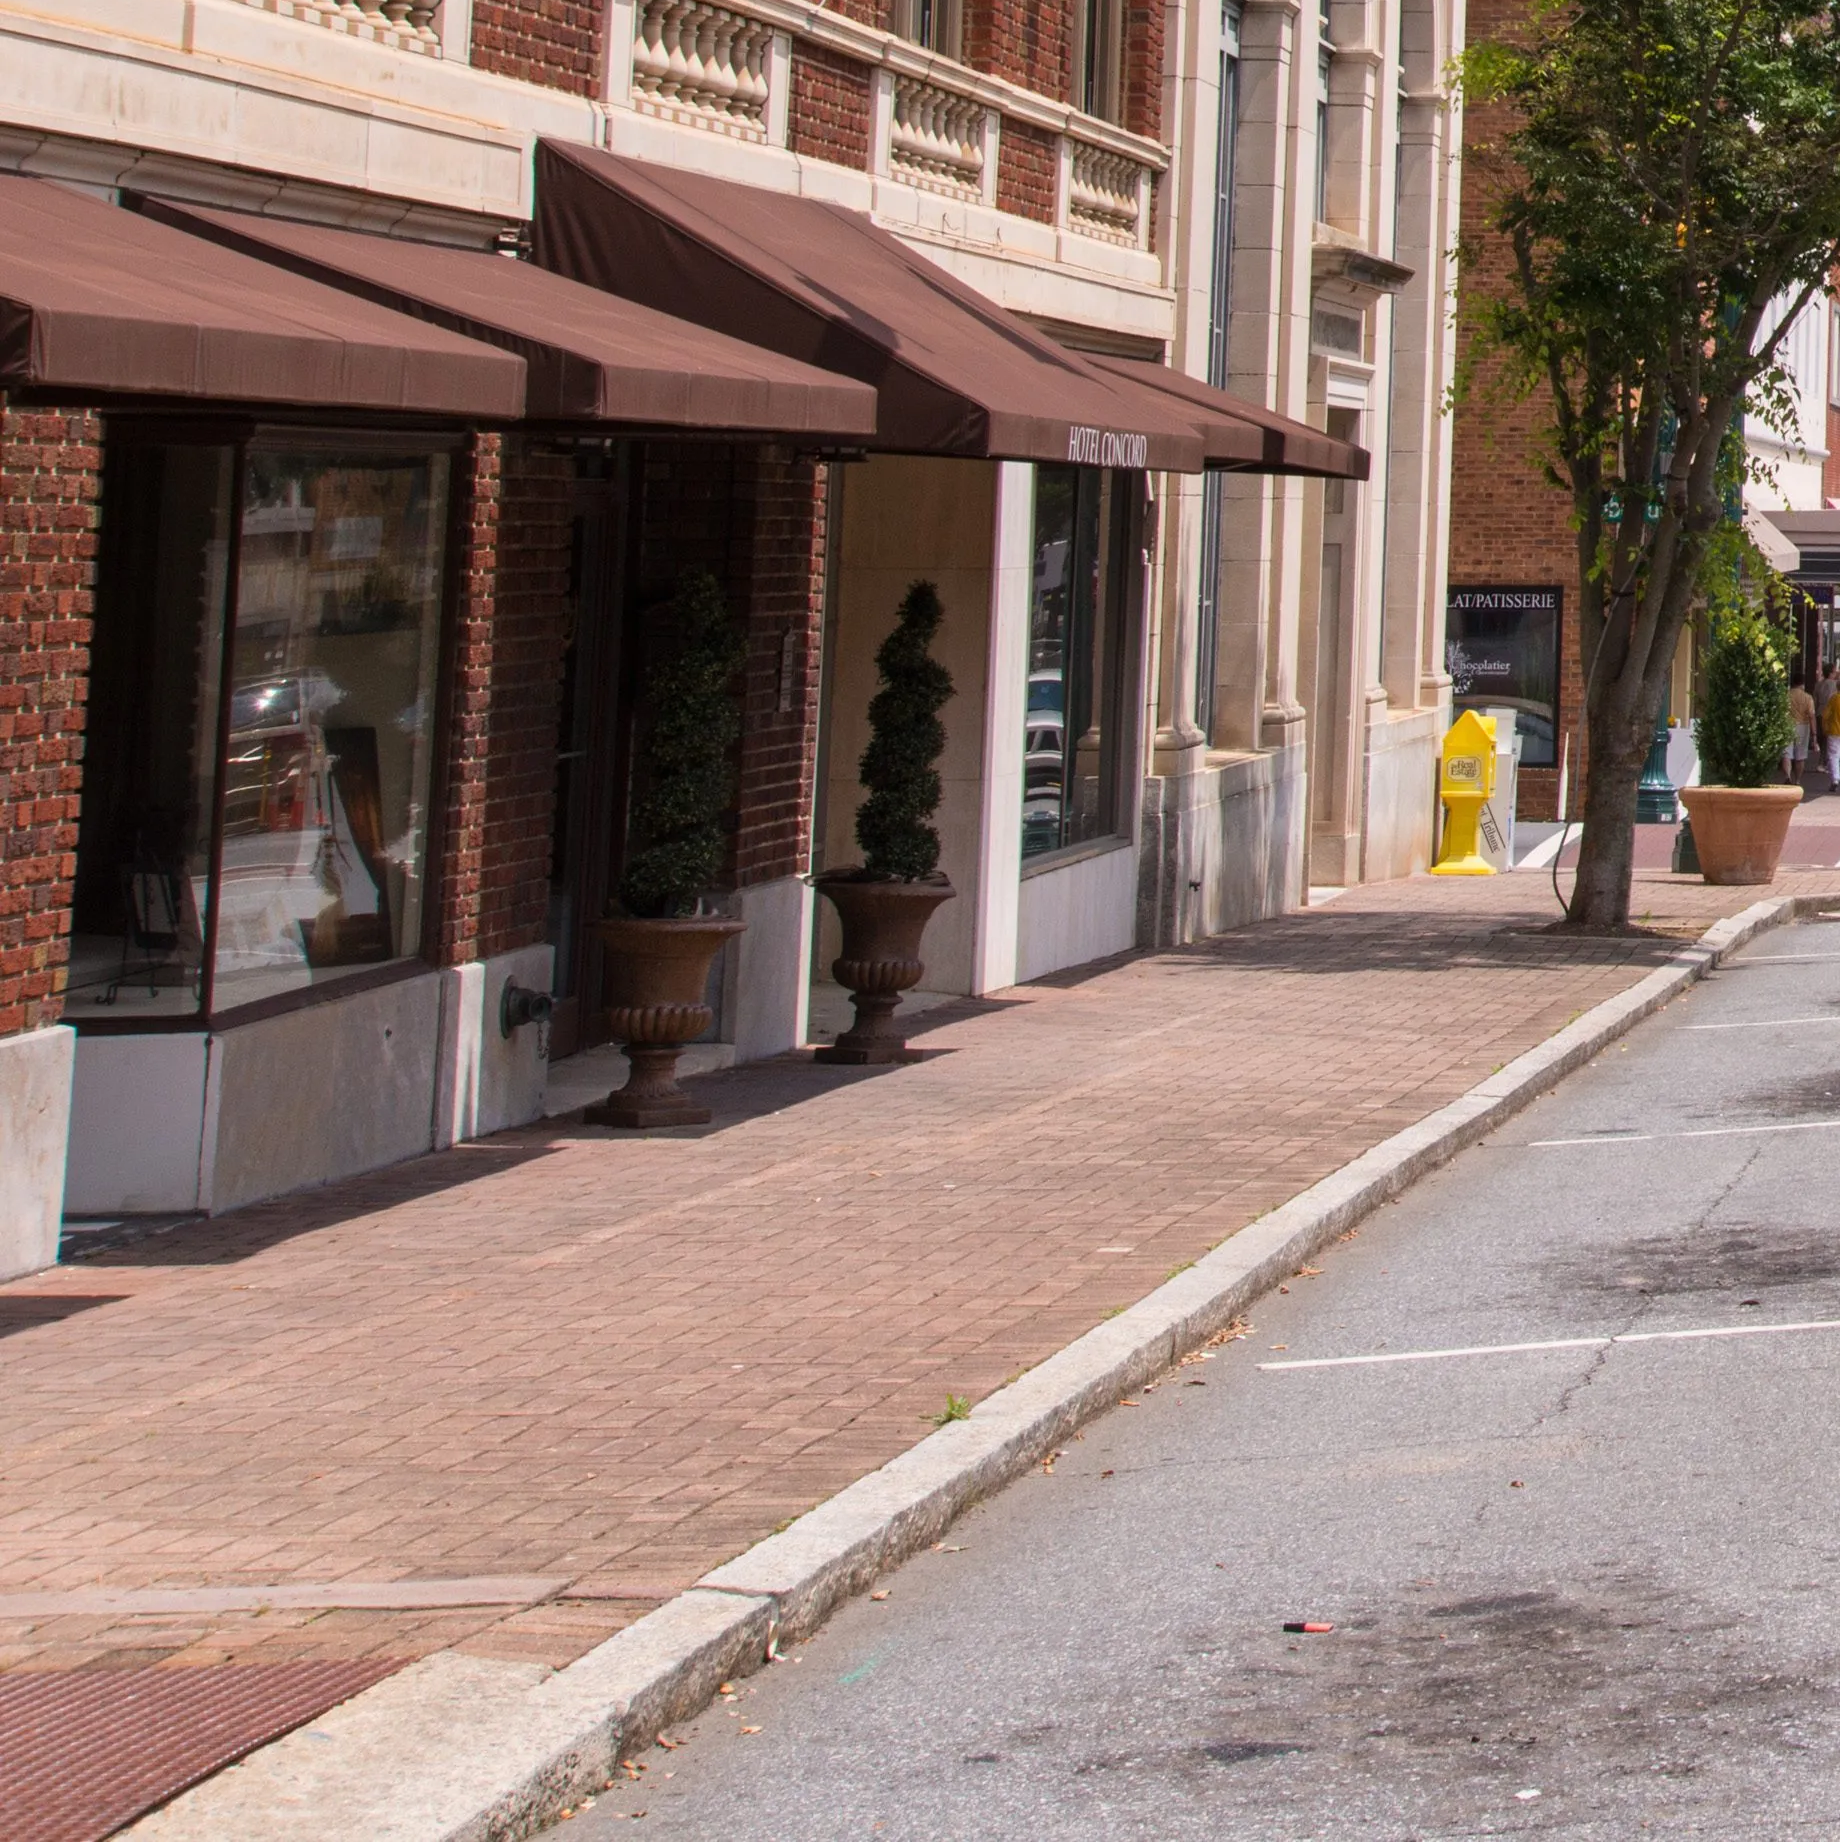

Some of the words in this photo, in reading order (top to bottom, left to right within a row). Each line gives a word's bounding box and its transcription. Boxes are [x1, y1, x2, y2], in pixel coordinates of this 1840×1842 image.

[1068, 426, 1100, 465] HOTEL
[1101, 432, 1148, 468] CONCORD
[1457, 760, 1477, 769] Real
[1483, 819, 1501, 852] Tribune
